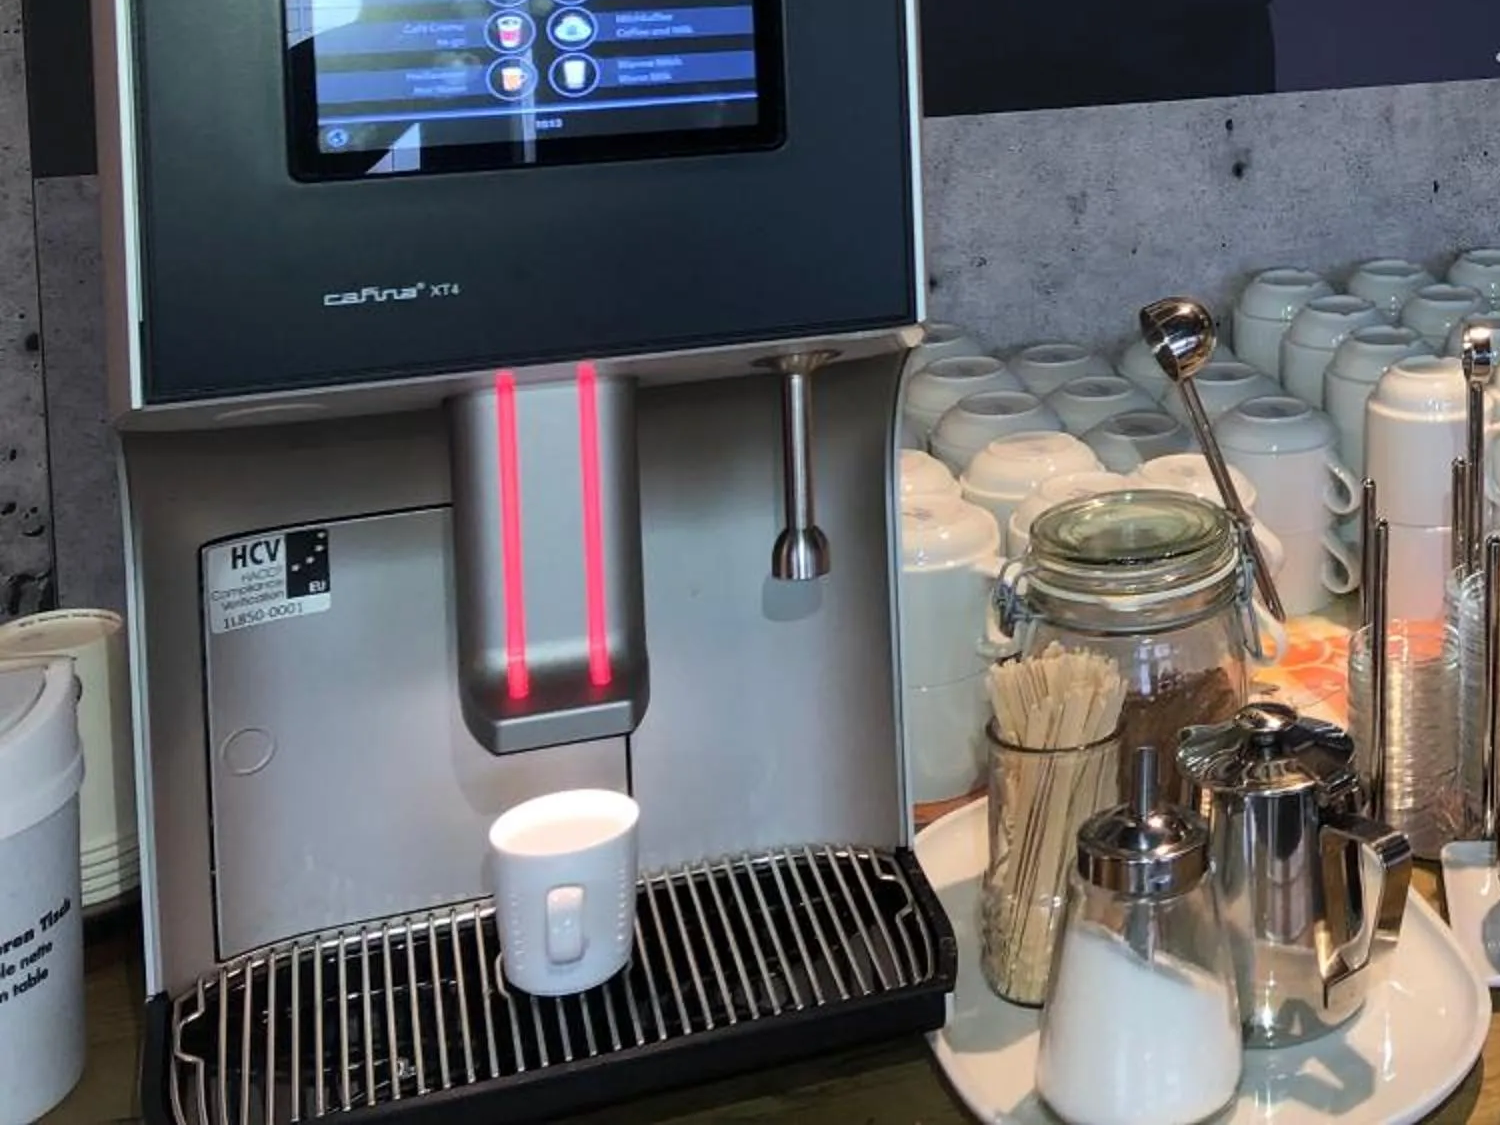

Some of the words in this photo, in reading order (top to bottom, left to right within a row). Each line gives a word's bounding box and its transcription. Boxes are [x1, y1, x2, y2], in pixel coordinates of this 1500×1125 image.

[430, 283, 460, 297] XT4
[231, 538, 280, 569] HCV
[308, 579, 327, 593] EU
[13, 966, 49, 996] table
